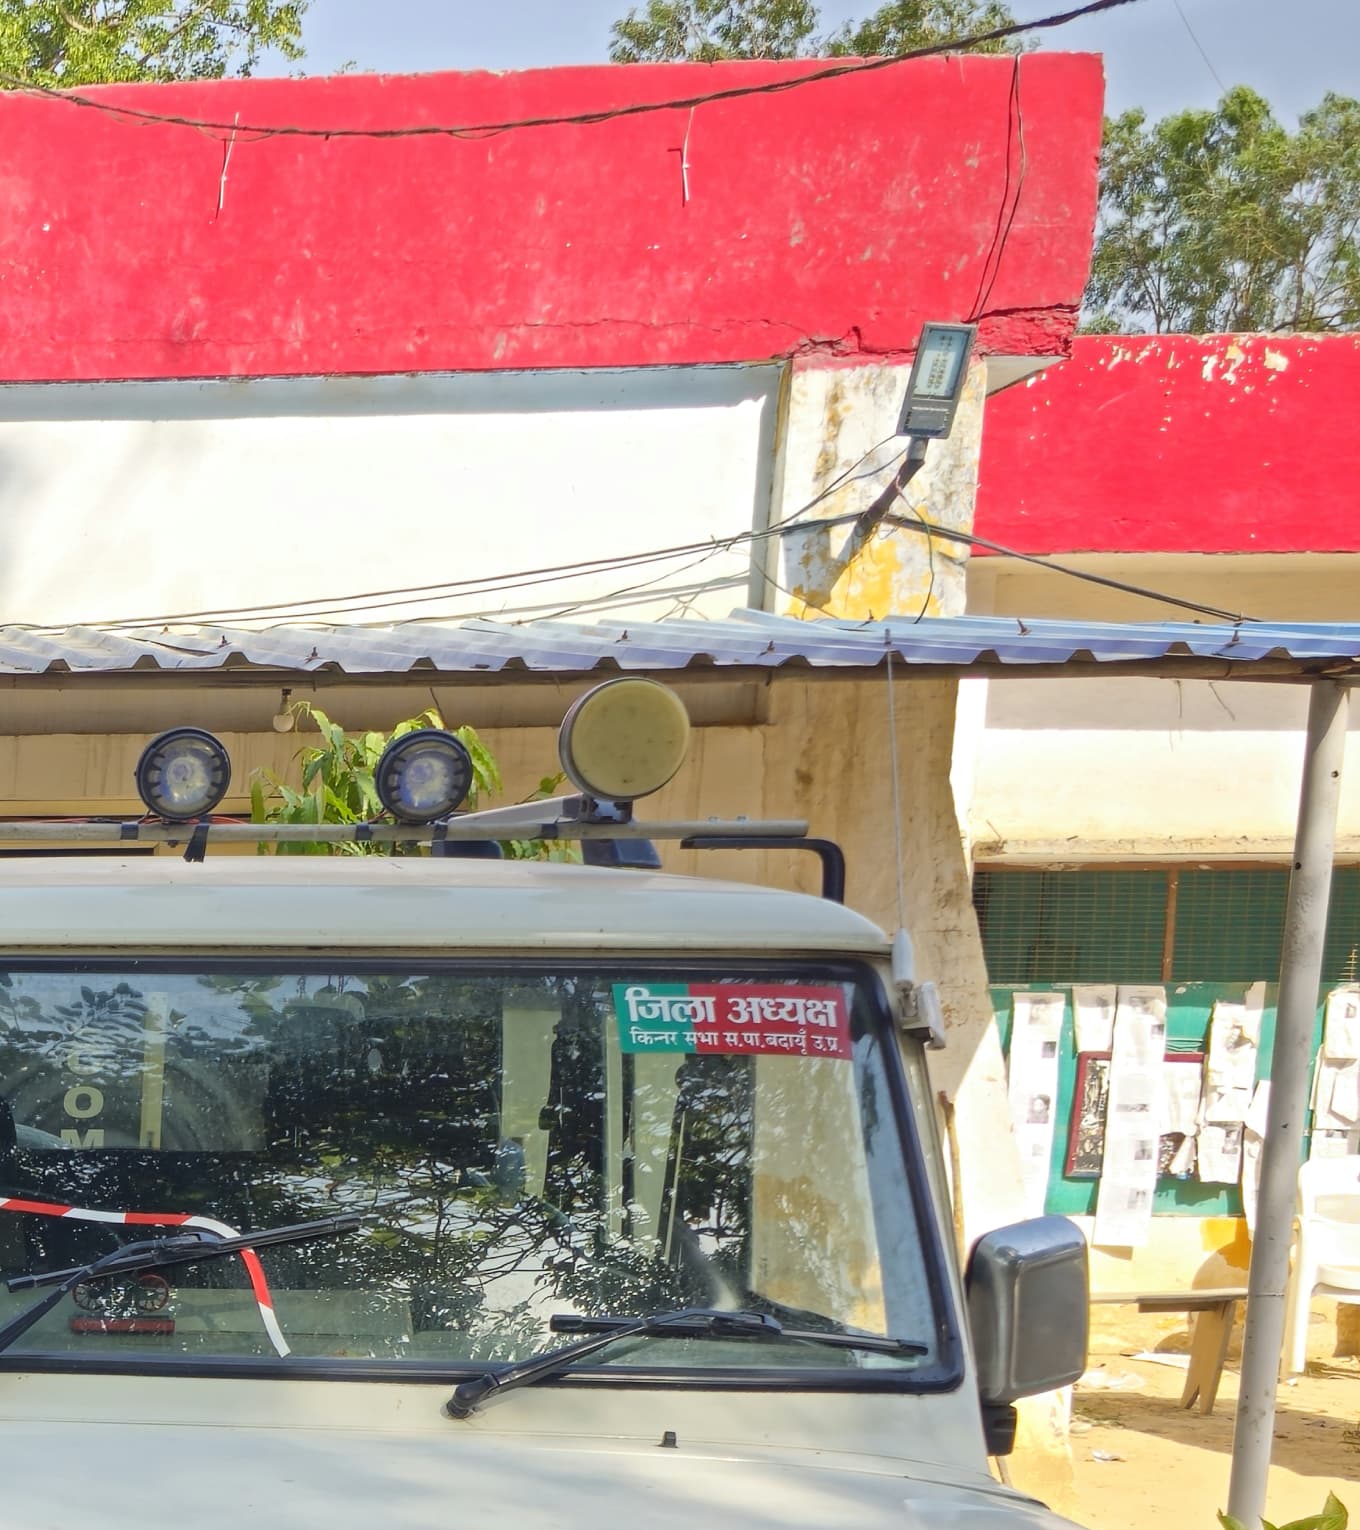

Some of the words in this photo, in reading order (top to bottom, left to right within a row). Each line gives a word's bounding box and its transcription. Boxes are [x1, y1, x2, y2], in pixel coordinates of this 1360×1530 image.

[624, 986, 716, 1025] जिला
[727, 996, 838, 1028] अध्यक्ष
[630, 1026, 678, 1046] किन्नर
[684, 1031, 719, 1046] सभा
